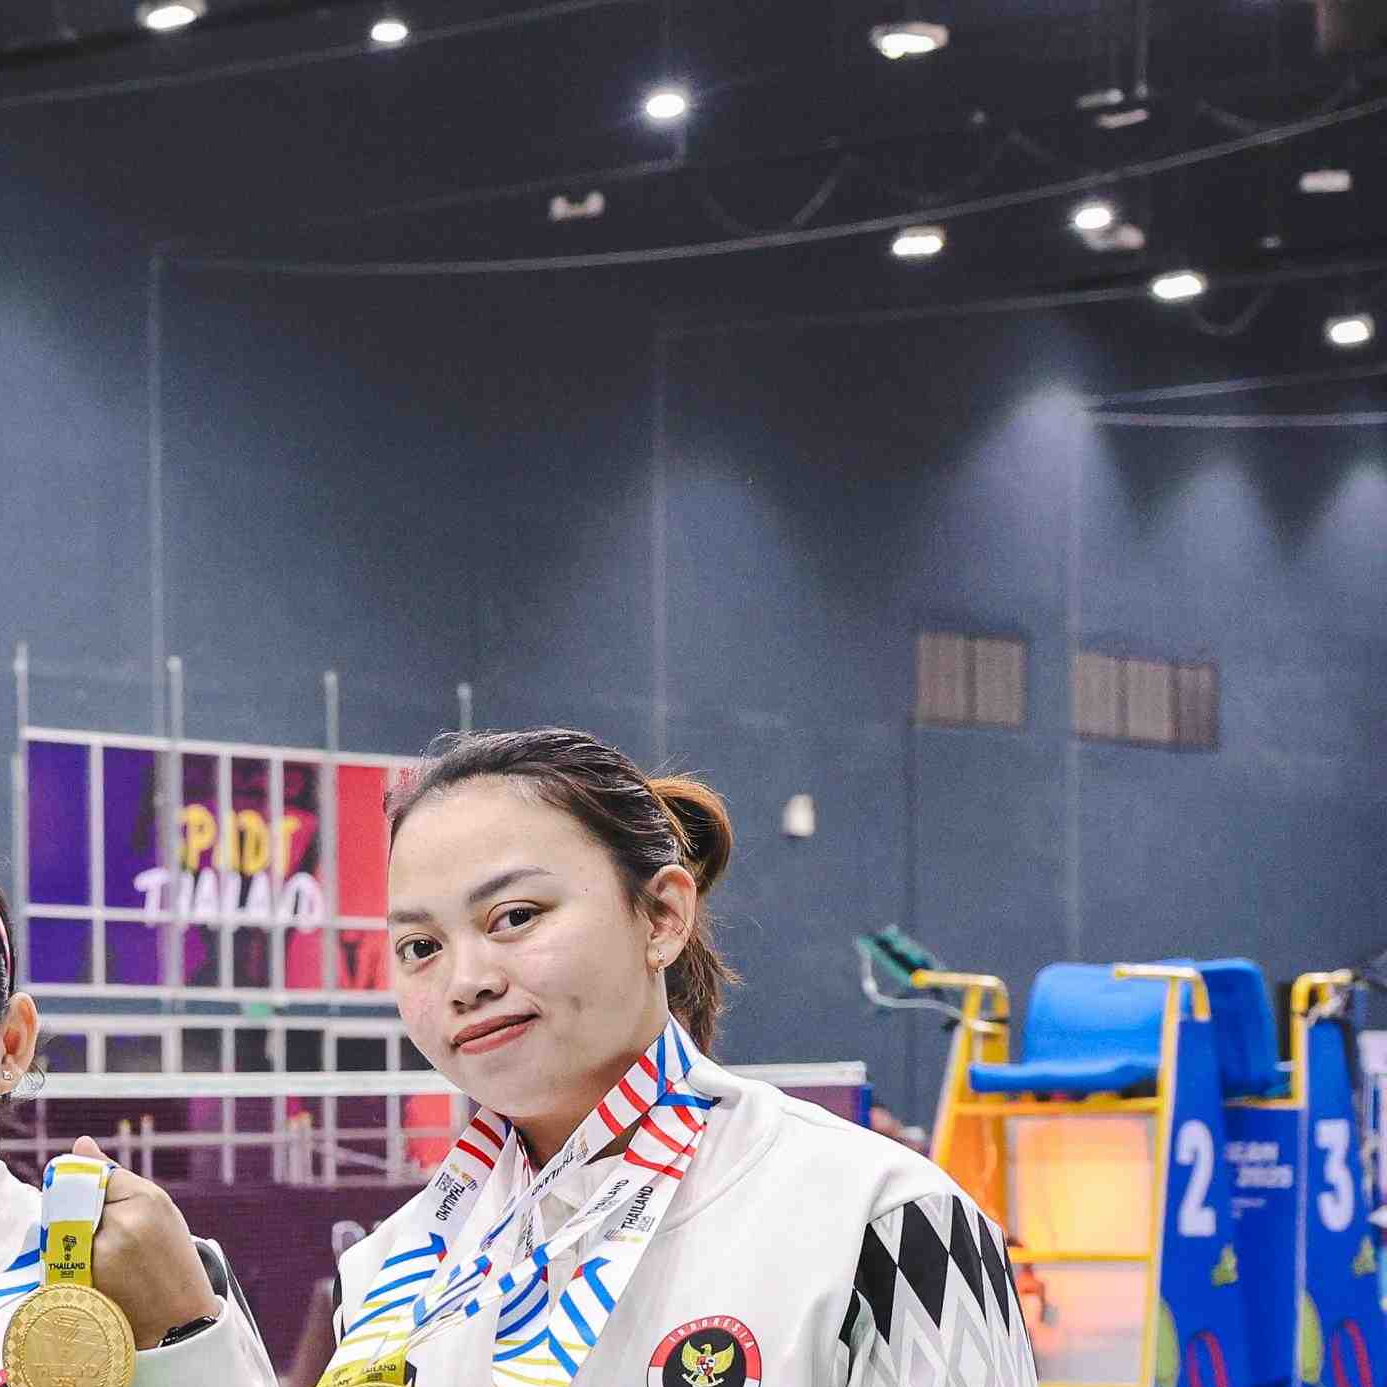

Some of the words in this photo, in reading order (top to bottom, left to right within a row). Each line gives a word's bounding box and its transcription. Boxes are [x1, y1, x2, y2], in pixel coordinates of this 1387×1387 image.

[620, 1185, 654, 1230] THAILAND
[1176, 1119, 1216, 1237] 2
[1314, 1119, 1355, 1231] 3
